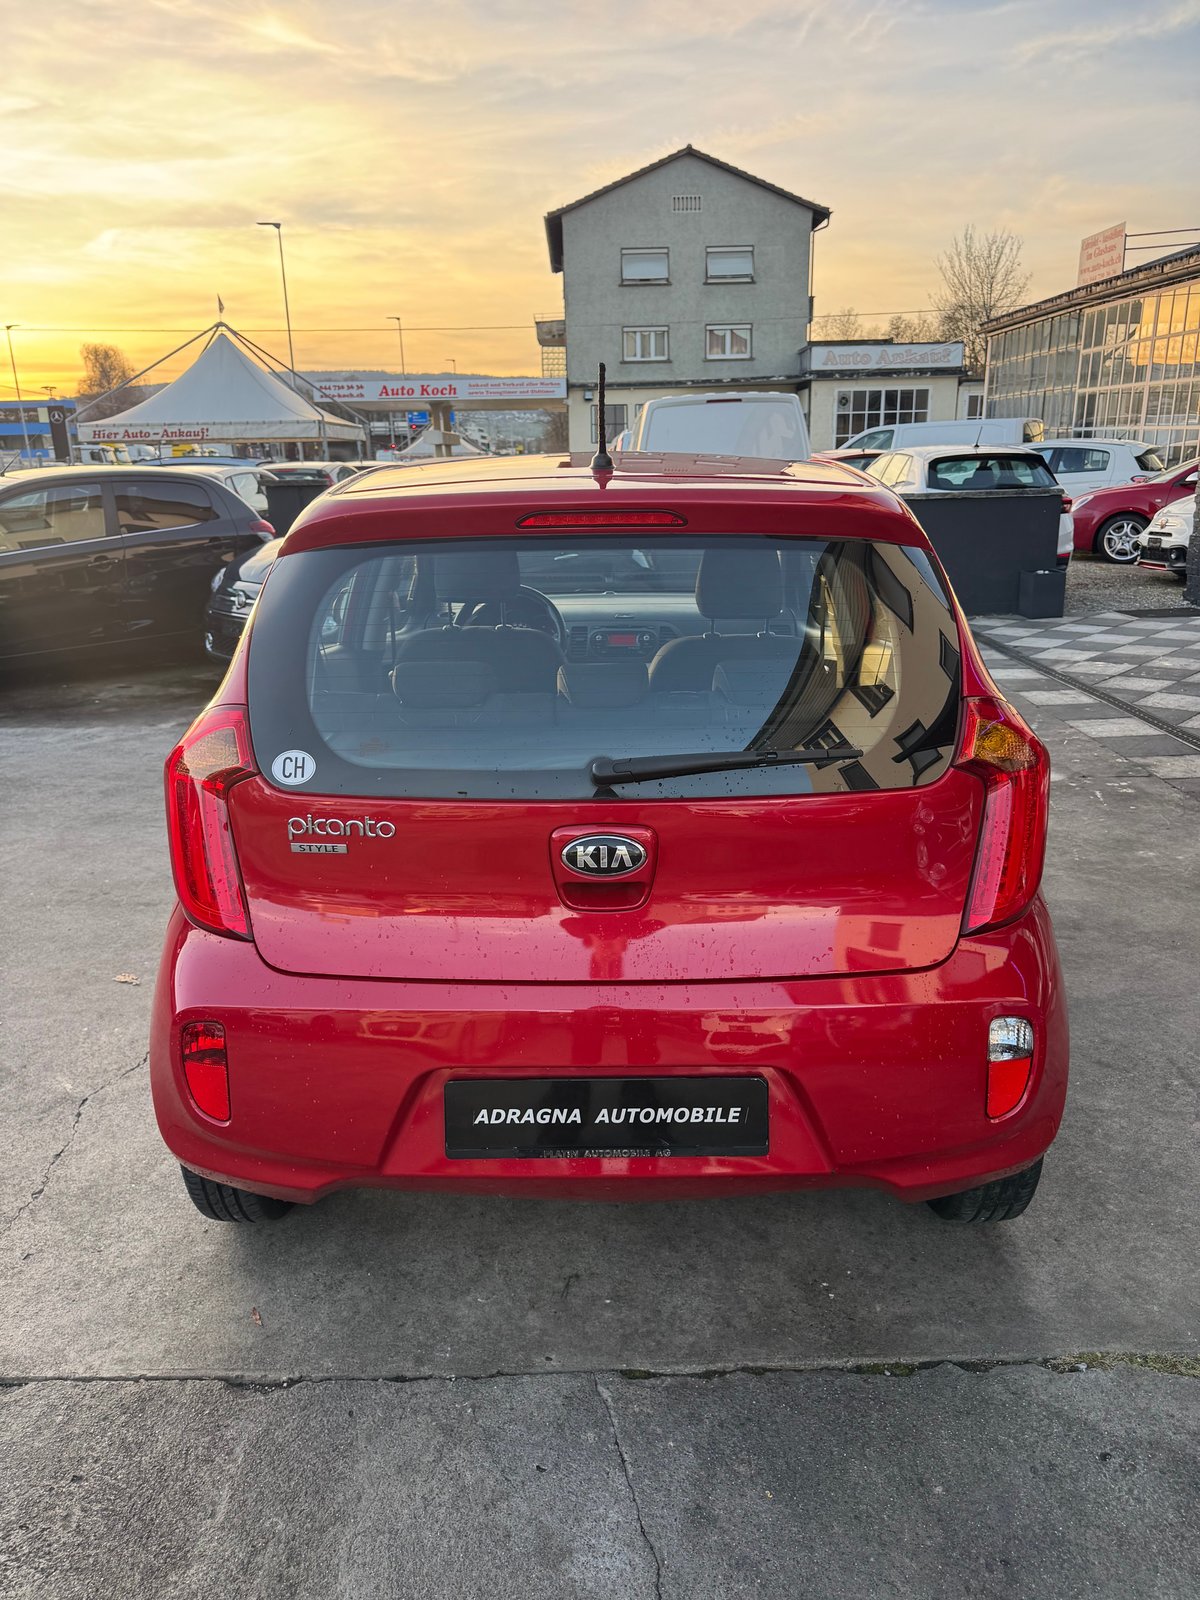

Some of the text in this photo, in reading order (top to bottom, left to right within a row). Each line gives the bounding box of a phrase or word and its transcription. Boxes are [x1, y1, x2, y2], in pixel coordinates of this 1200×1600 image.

[822, 347, 953, 366] Auto Ankauf
[379, 384, 457, 397] Auto Koch
[92, 429, 119, 440] Hier
[282, 756, 306, 779] CH
[287, 813, 396, 841] picanto
[298, 844, 339, 853] STYLE
[576, 845, 633, 868] KIA
[473, 1107, 742, 1125] ADRAGNA AUTOMOBILE
[583, 1148, 651, 1158] AUTOMOBILE
[655, 1148, 672, 1158] AG
